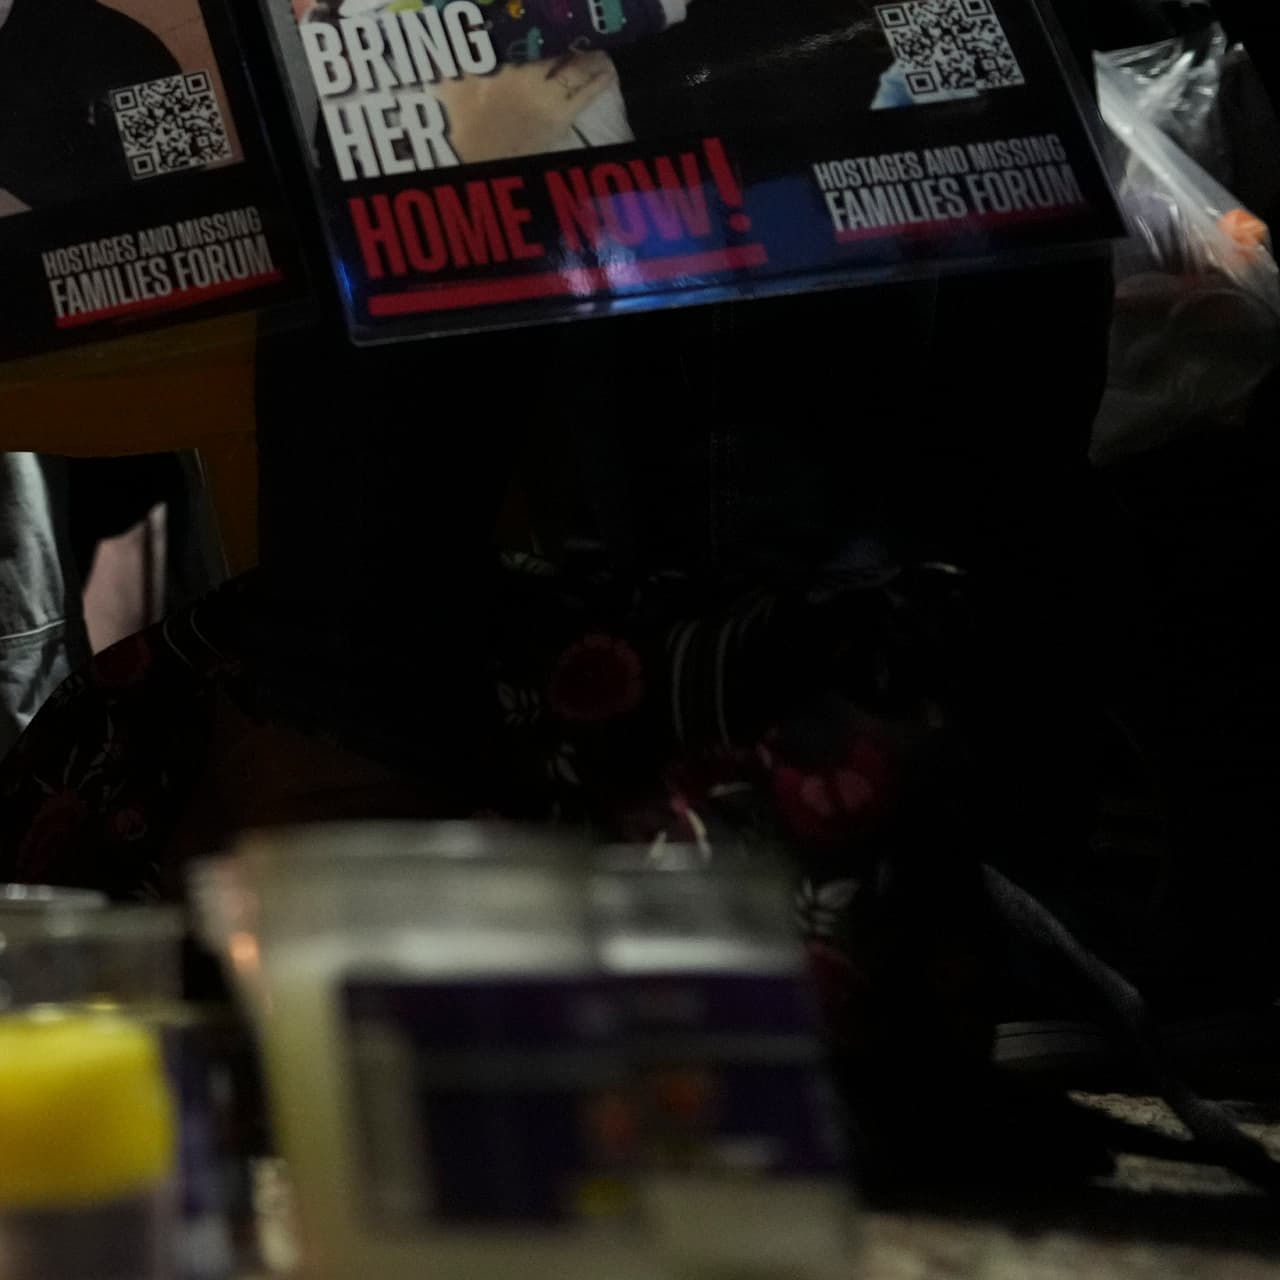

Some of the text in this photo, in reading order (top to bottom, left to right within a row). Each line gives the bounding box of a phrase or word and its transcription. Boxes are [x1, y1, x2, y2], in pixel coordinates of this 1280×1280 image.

[299, 0, 497, 99] BRING
[323, 91, 460, 182] HER
[813, 134, 1067, 192] HOSTAGES AND MISSING
[348, 136, 751, 278] HOME NOW!
[824, 165, 1083, 234] FAMILIES FORUM
[42, 205, 262, 276] HOSTAGES AND MISSING
[50, 237, 274, 317] FAMILIES FORUM
